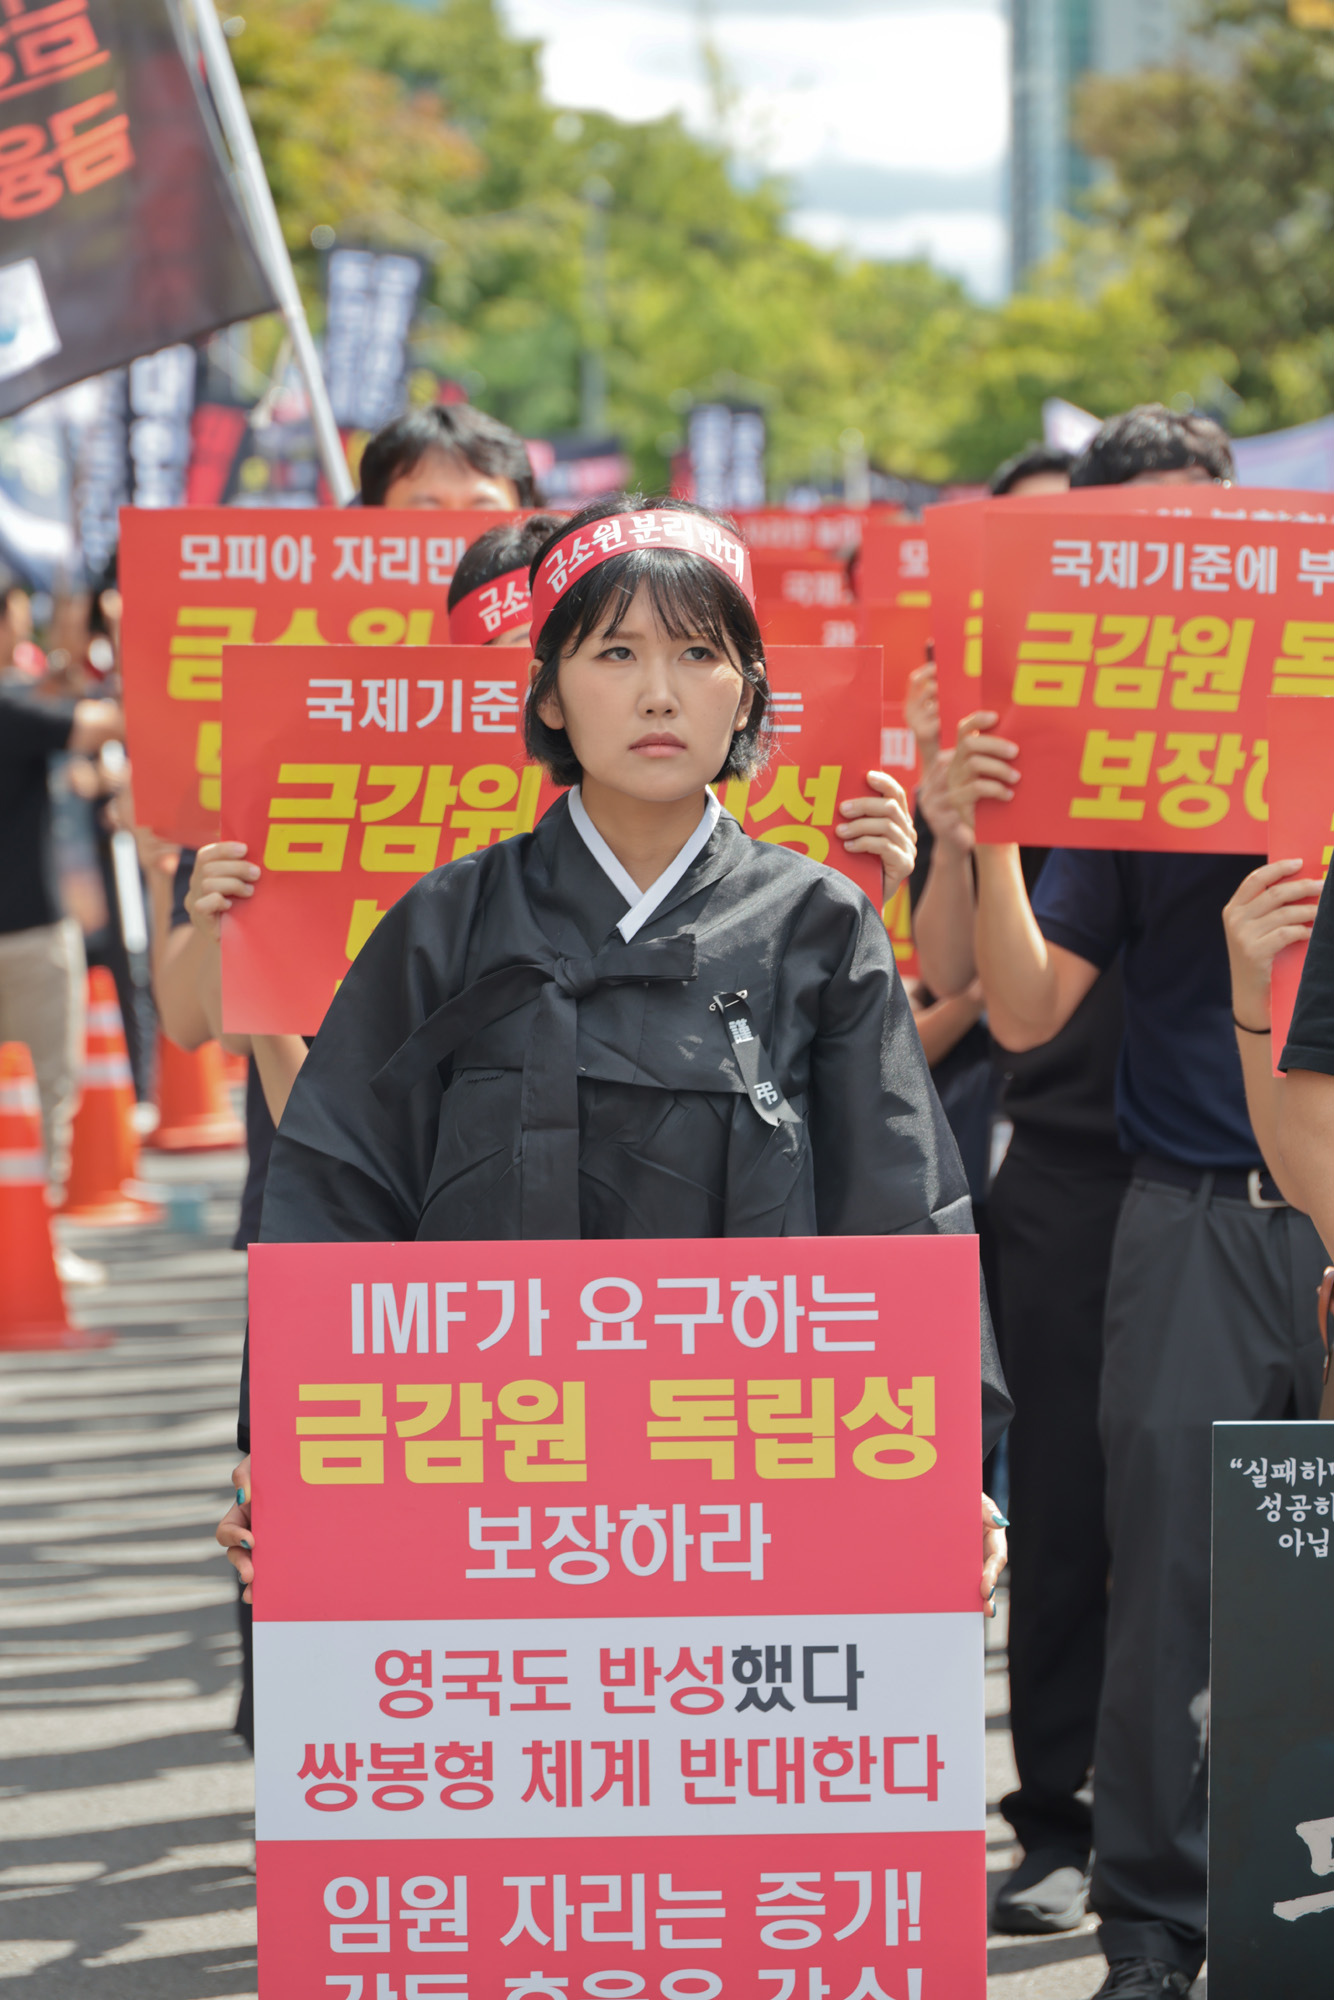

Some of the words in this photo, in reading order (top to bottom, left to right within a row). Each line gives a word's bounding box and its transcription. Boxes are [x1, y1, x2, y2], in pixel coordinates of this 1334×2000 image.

[179, 534, 316, 584] 모피아
[544, 519, 627, 594] 금소원
[628, 512, 694, 548] 분리
[697, 524, 745, 584] 반대
[1051, 539, 1278, 595] 국제기준에
[478, 580, 532, 632] 금소
[1012, 611, 1255, 712] 금감원
[305, 678, 533, 734] 국제기준
[257, 762, 544, 873] 금감원
[350, 1278, 550, 1357] IMF가
[576, 1274, 880, 1356] 요구하는
[295, 1379, 588, 1485] 금감원
[646, 1375, 938, 1481] 독립성
[465, 1501, 772, 1586] 보장하라
[374, 1648, 571, 1719] 영국도
[599, 1643, 865, 1716] 반성했다
[296, 1741, 494, 1813] 쌍봉형
[520, 1739, 650, 1808] 체계
[680, 1734, 945, 1806] 반대한다
[323, 1875, 469, 1954] 임원
[500, 1873, 726, 1952] 자리는
[755, 1869, 922, 1950] 증가!
